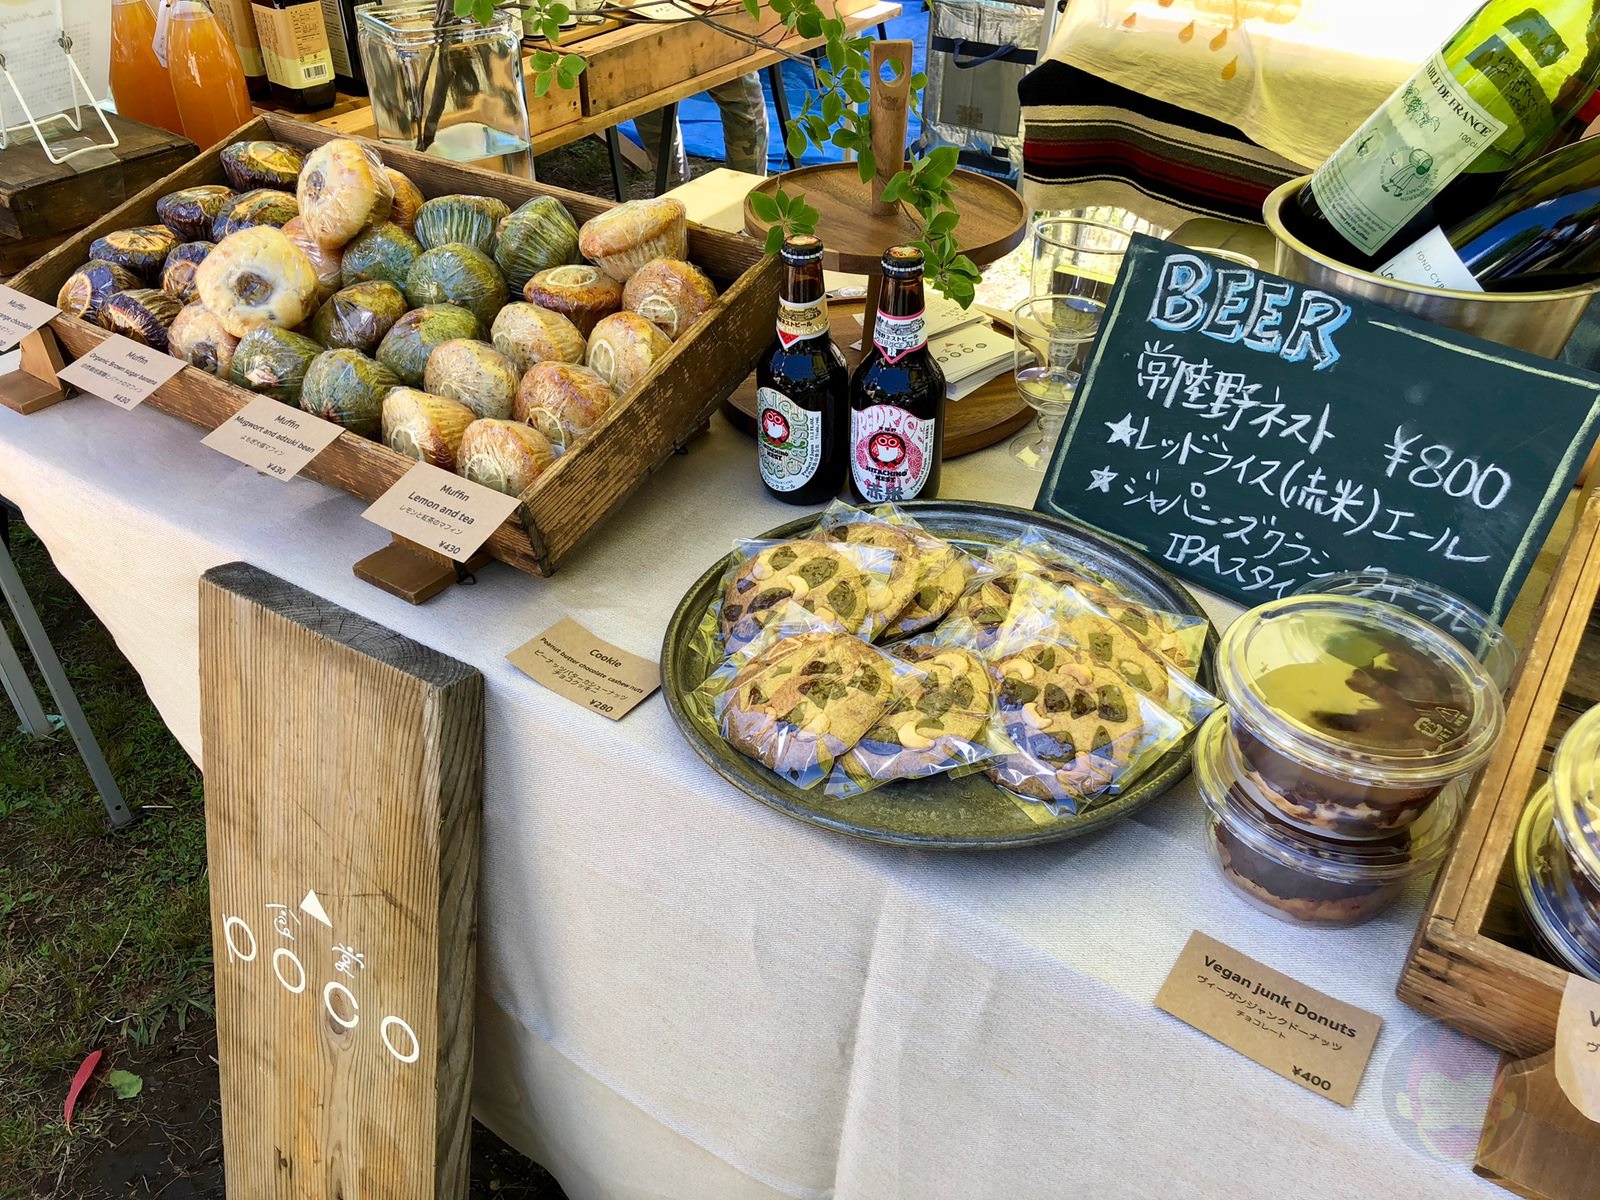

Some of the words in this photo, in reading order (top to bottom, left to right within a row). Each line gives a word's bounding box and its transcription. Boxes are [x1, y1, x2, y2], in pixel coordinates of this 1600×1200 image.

[1437, 85, 1453, 102] DE
[1448, 98, 1492, 137] FRANCE
[1459, 132, 1472, 144] 100
[1146, 253, 1352, 371] BEER
[89, 352, 109, 365] Organic
[108, 361, 125, 372] Brown
[124, 369, 140, 379] sugar
[138, 374, 158, 386] banana
[126, 351, 149, 365] Muffin
[113, 393, 131, 405] ¥430
[1137, 341, 1335, 454] 常陸野ネスト
[234, 415, 264, 433] Mugwort
[262, 427, 278, 438] and
[275, 433, 300, 447] adzuki
[297, 441, 315, 454] bean
[274, 414, 300, 430] Muffin
[266, 462, 287, 475] ¥430
[1384, 424, 1512, 509] ¥800
[439, 484, 470, 502] Muffin
[399, 504, 463, 535] レモンと紅茶のマフィン
[408, 491, 440, 511] Lemon
[439, 506, 461, 519] and
[459, 513, 476, 526] tea
[438, 540, 461, 555] ¥430
[540, 636, 561, 654] Peanut
[560, 650, 579, 666] butter
[578, 662, 608, 680] chocolate
[607, 676, 630, 689] cashew
[629, 685, 645, 695] nuts
[589, 649, 622, 669] Cookie
[552, 669, 598, 694] チョコクッキー
[589, 698, 614, 713] ¥280
[1204, 955, 1252, 990] Vegan
[1251, 982, 1292, 1010] junk
[1294, 1002, 1358, 1039] Donuts
[1196, 974, 1343, 1052] ヴィーガンジャンクドーナッツ
[1236, 1010, 1287, 1039] チョコレート
[1292, 1065, 1332, 1091] ¥400
